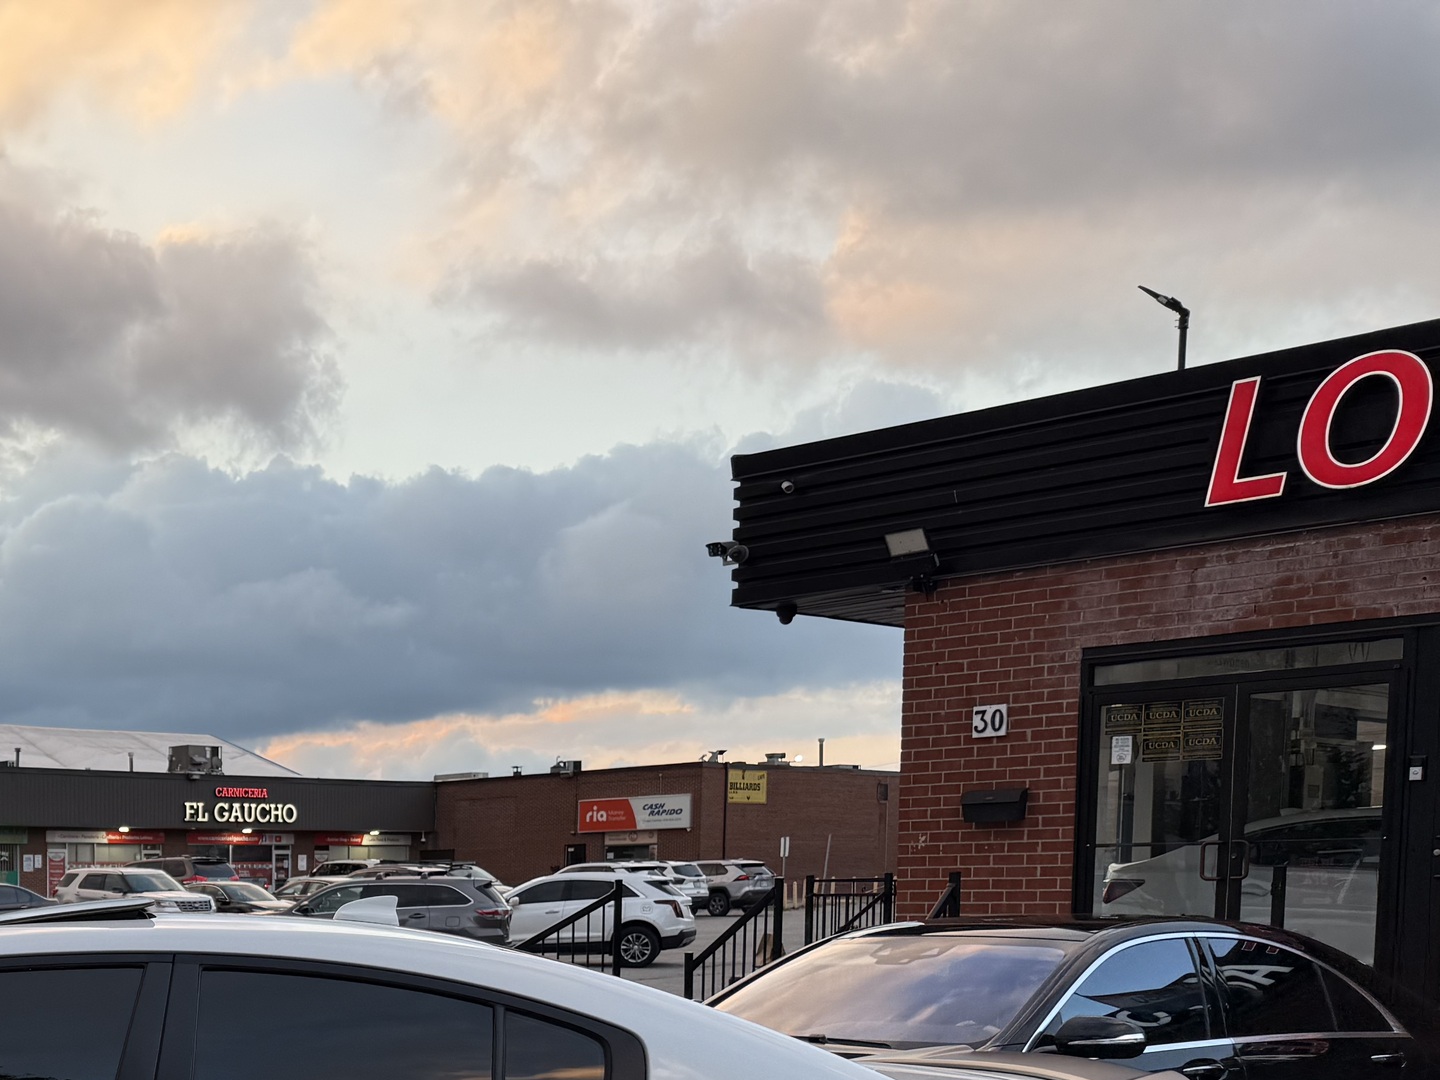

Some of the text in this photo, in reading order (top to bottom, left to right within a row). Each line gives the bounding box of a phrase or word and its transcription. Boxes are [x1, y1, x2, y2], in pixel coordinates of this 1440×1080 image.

[1204, 349, 1433, 507] LO
[1111, 713, 1137, 721] UCDA
[1149, 710, 1177, 719] UCDA
[1189, 708, 1217, 717] UCDA
[974, 709, 1004, 734] 30
[1149, 741, 1175, 749] UCDA
[1188, 737, 1217, 746] UCDA
[729, 782, 760, 791] BILLIARDS
[215, 787, 268, 798] CARNICERIA
[642, 803, 665, 811] CASH
[184, 802, 298, 823] EL GAUCHO
[586, 805, 607, 823] ria
[648, 808, 683, 817] RAPIDO
